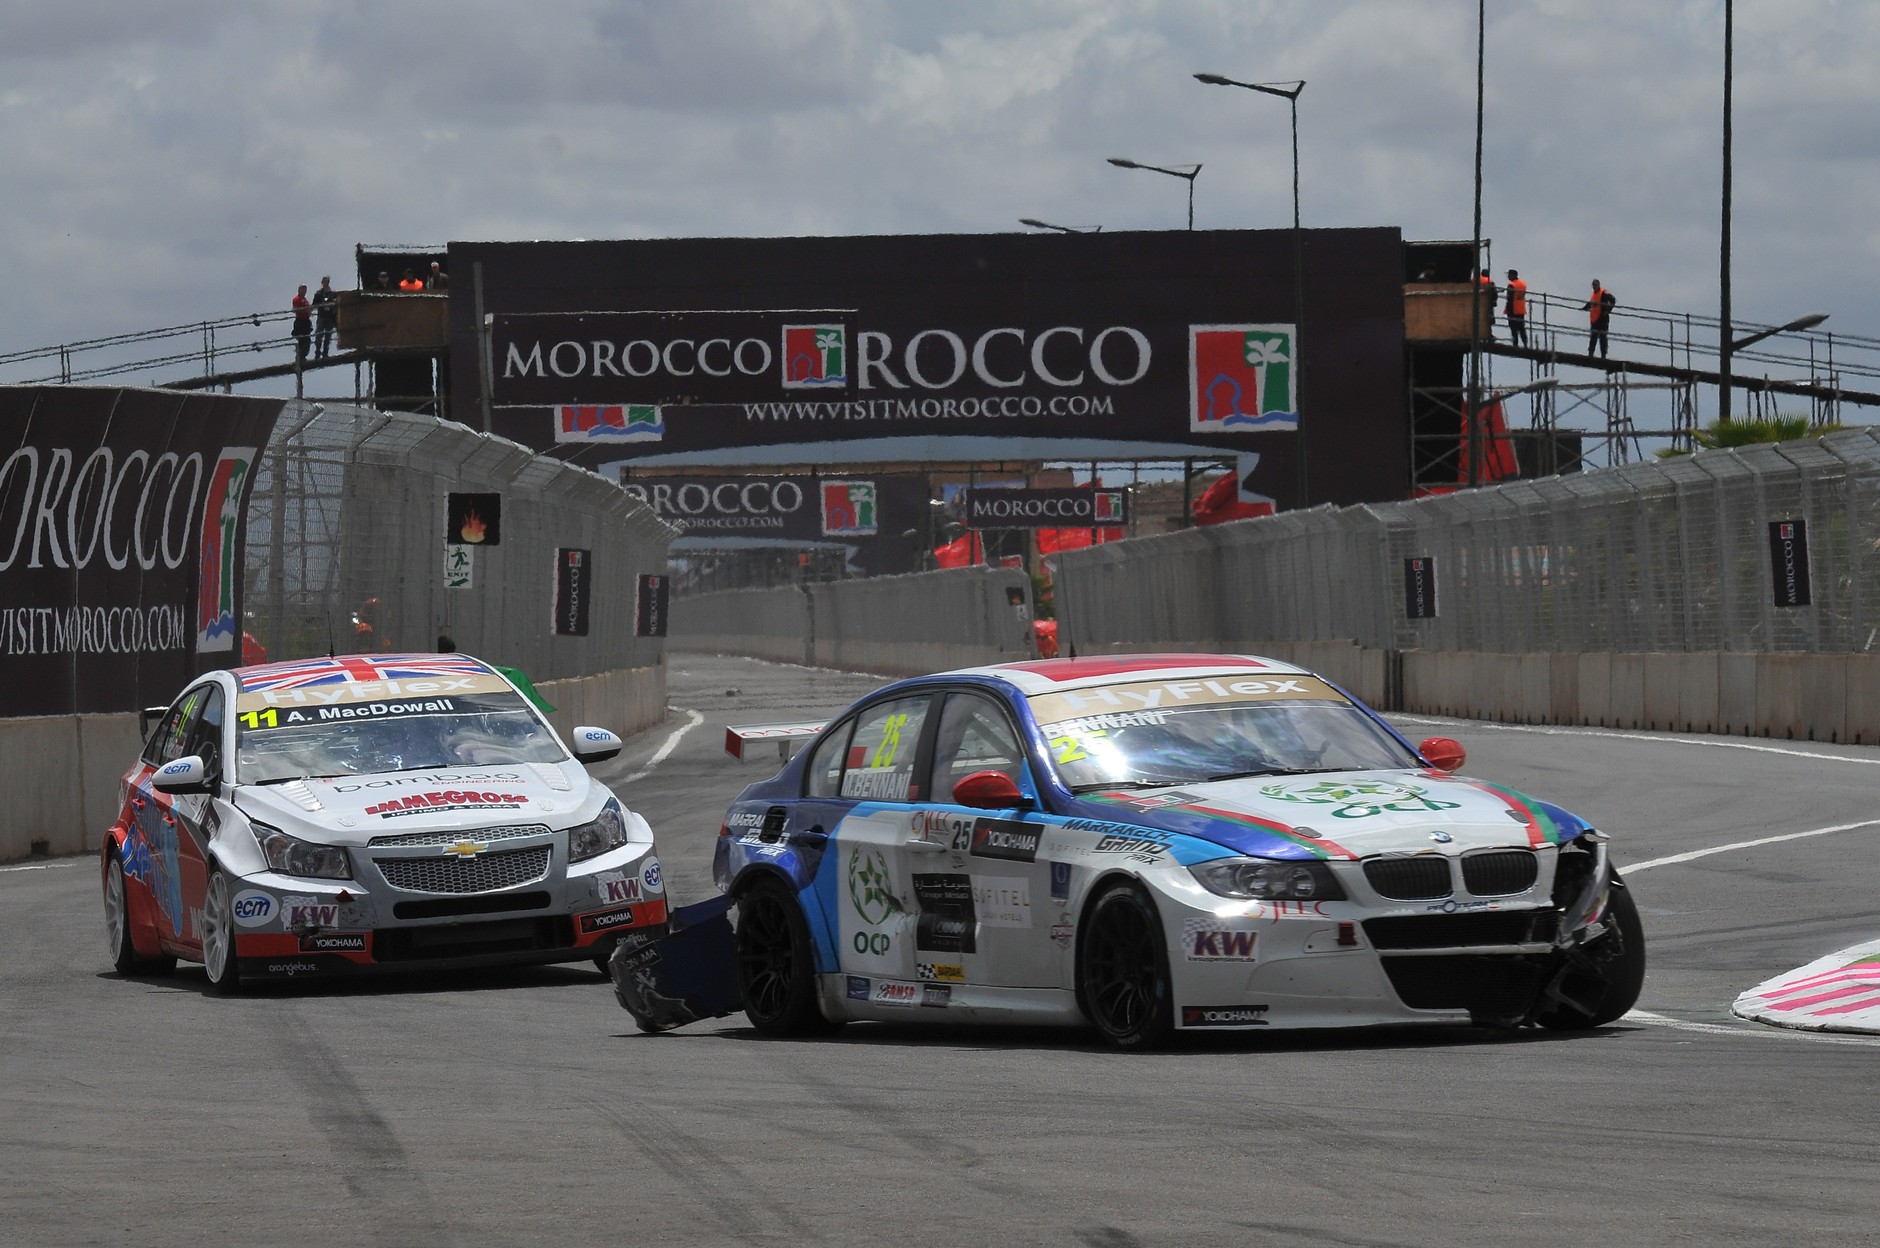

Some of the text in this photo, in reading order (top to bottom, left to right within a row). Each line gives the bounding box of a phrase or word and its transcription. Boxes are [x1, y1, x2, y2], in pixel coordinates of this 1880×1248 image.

[503, 337, 772, 379] MOROCCO
[743, 396, 1116, 422] WWW.VISITMOROCCO.COM
[973, 498, 1091, 517] MOROCCO
[1786, 540, 1798, 604] MOROCCO
[569, 568, 580, 633] MOROCCO
[262, 677, 478, 705] HyFlex
[1061, 677, 1310, 709] HyFlex
[240, 699, 455, 728] 11 A. MacDowall
[586, 730, 611, 741] ecm
[871, 713, 908, 769] 25
[163, 762, 192, 775] ecm
[333, 771, 521, 794] bamboo
[390, 806, 445, 817] INTIMO
[952, 820, 973, 850] 25
[987, 830, 1037, 851] YOKOHAMA
[1061, 819, 1176, 841] MARRAKECH
[1095, 834, 1174, 855] GRAND
[1124, 853, 1161, 865] PRIX
[606, 878, 640, 902] KW
[234, 896, 271, 918] ecm
[291, 906, 338, 925] KW
[594, 911, 632, 926] YOKOHAMA
[315, 938, 363, 948] YOKOHAMA
[854, 930, 891, 956] OCP
[1193, 931, 1258, 957] KW
[268, 961, 320, 976] orangebus.
